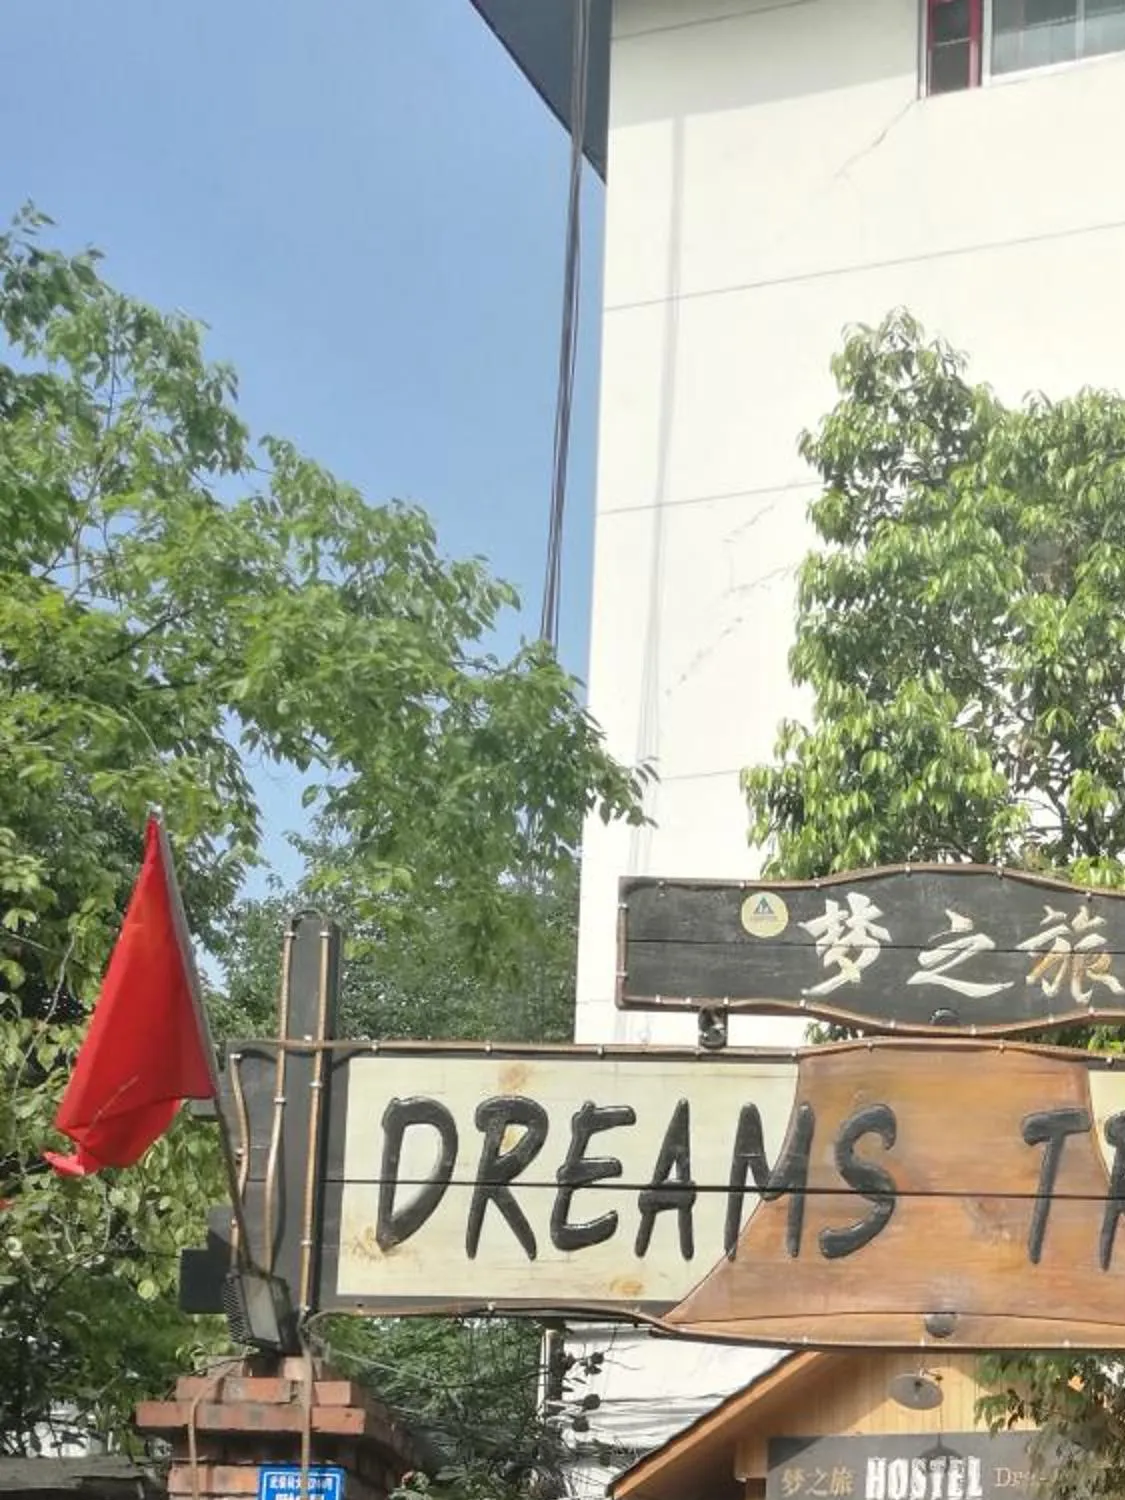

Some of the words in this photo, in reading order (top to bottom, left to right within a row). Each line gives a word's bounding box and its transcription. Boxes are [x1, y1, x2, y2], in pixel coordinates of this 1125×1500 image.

[374, 1095, 898, 1261] DREAMS
[781, 1466, 854, 1498] 梦之旅
